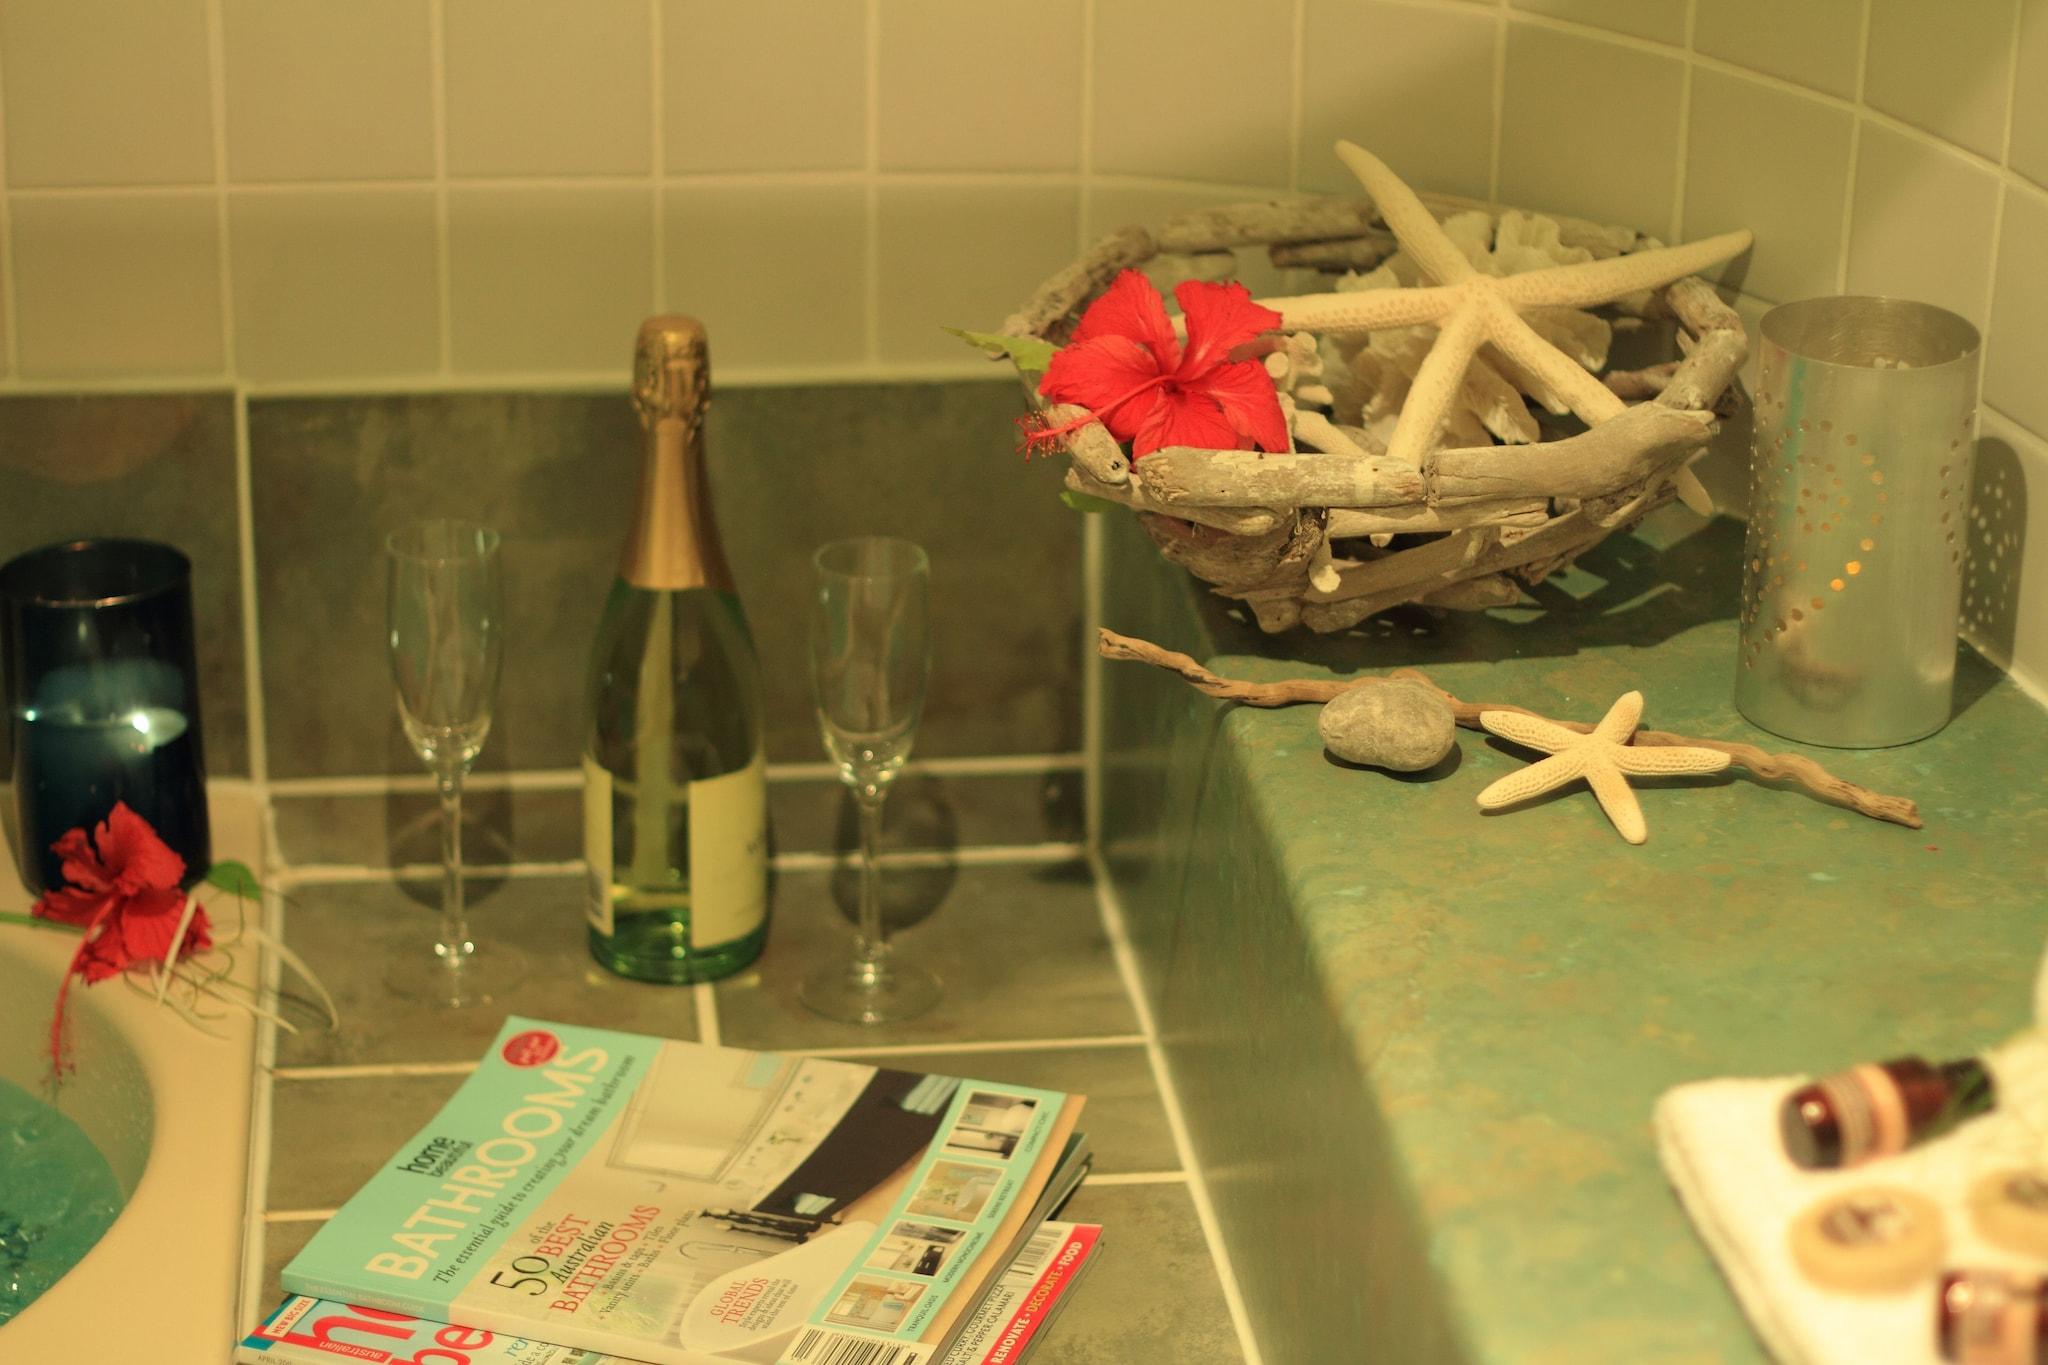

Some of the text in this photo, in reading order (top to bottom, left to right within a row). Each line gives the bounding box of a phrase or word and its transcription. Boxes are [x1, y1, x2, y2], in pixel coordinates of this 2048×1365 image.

[364, 1046, 609, 1281] BATHROOMS
[396, 1136, 456, 1174] home
[433, 1055, 635, 1284] The essential guide to creating your dream bathroom
[490, 1213, 590, 1296] 50 BEST
[530, 1221, 556, 1245] of the
[549, 1205, 661, 1313] BATHROOMS
[550, 1221, 614, 1284] Australian
[603, 1268, 628, 1290] Basins
[621, 1260, 634, 1268] &
[643, 1226, 664, 1241] Tiles
[599, 1292, 629, 1313] Vanity
[622, 1274, 640, 1292] units
[637, 1249, 660, 1268] Baths
[710, 1281, 747, 1316] GLOBAL
[720, 1278, 768, 1323] TRENDS
[990, 1241, 1083, 1364] RENOVATE DECORATE FOOD
[271, 1320, 286, 1334] NEW
[283, 1310, 299, 1324] BIG
[319, 1340, 384, 1360] australian
[971, 1324, 993, 1346] PEPPER
[987, 1291, 1016, 1324] CALAMARI
